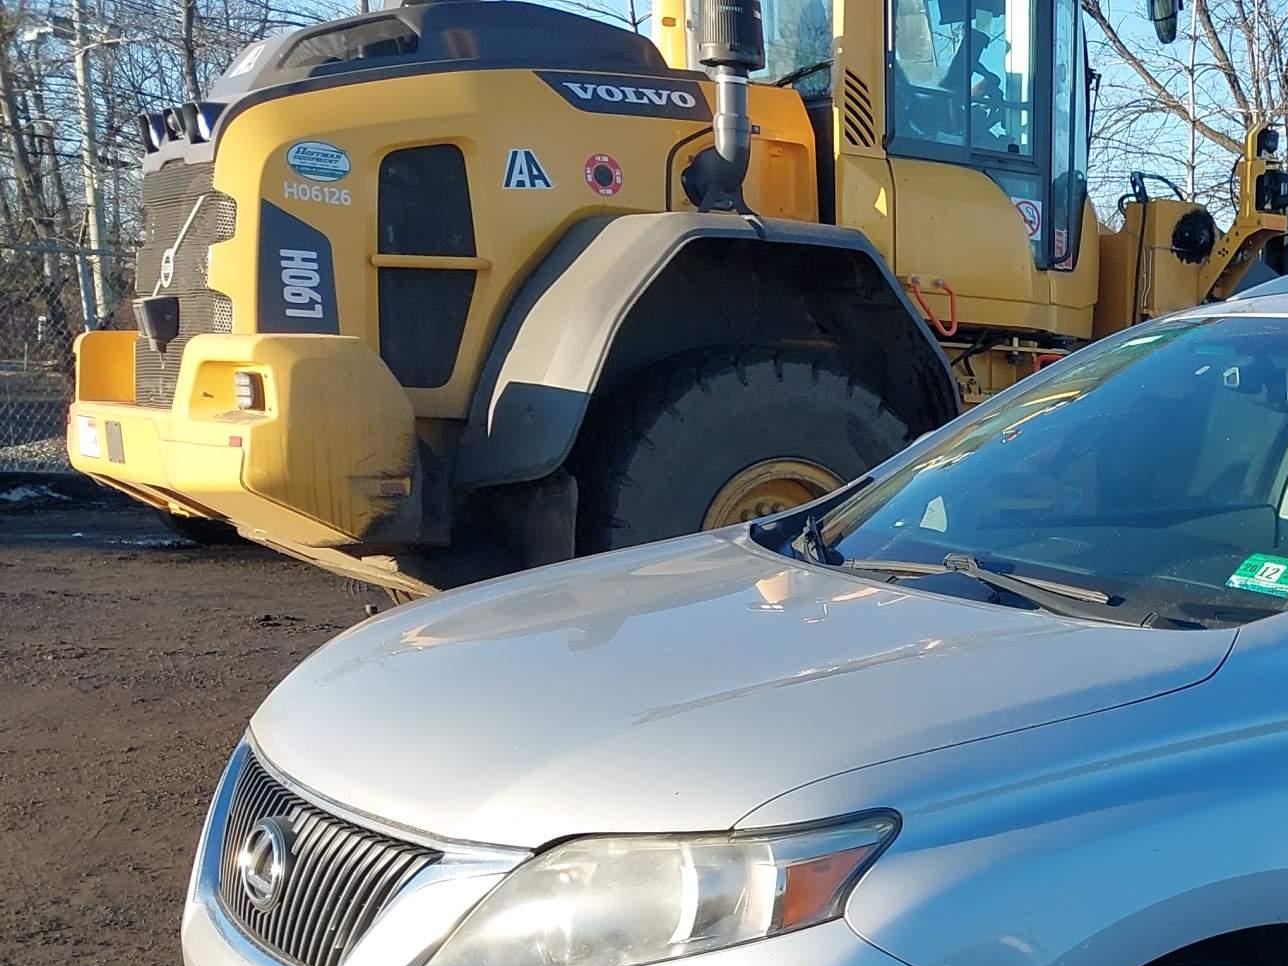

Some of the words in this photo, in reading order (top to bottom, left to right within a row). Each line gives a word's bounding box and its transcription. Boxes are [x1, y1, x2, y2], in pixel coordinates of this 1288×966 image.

[562, 82, 696, 108] VOLVO
[284, 181, 352, 206] H06126
[279, 248, 324, 318] L90H
[1259, 566, 1281, 579] 12
